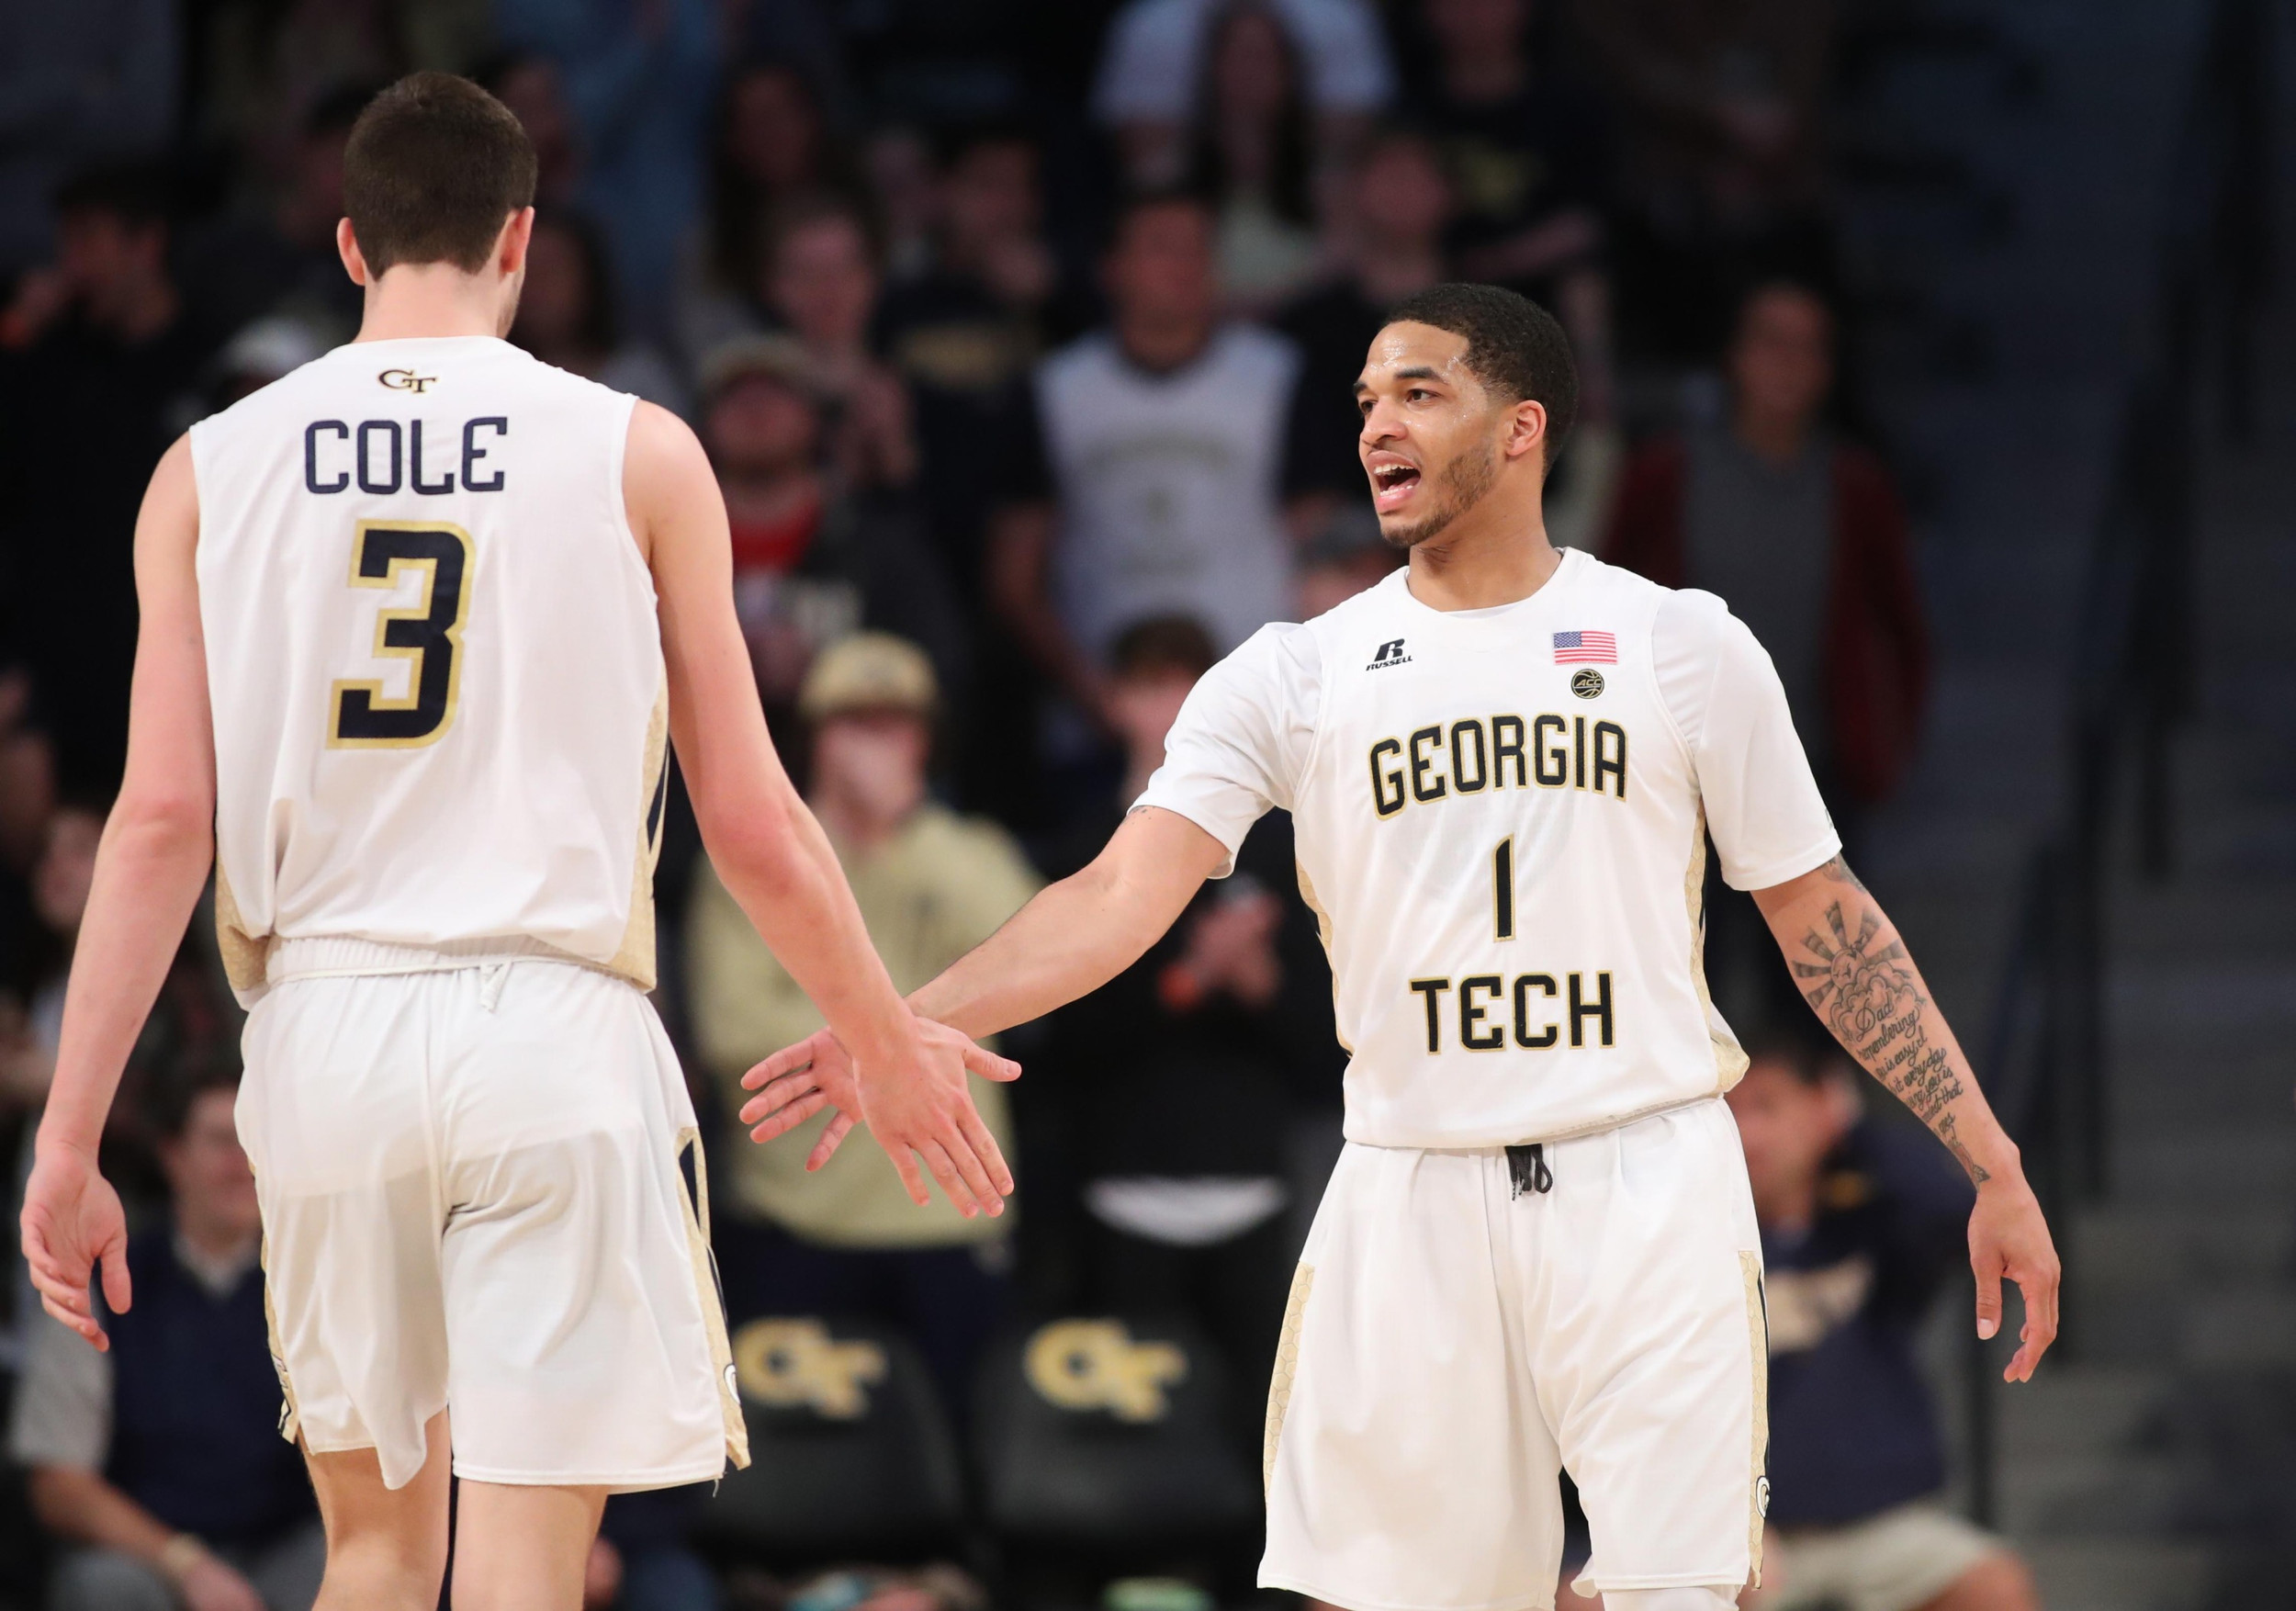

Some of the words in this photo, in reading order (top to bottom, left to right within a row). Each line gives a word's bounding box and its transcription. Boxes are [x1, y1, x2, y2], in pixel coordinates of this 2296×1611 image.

[377, 368, 437, 395] GT
[304, 416, 508, 495] COLE
[325, 519, 477, 750] 3
[1366, 655, 1413, 671] RUSSELL
[1576, 679, 1602, 688] ACC
[1368, 713, 1629, 821] GEORGIA
[1491, 832, 1516, 943] 1
[1409, 970, 1617, 1055] TECH
[1855, 997, 1895, 1042] Dad
